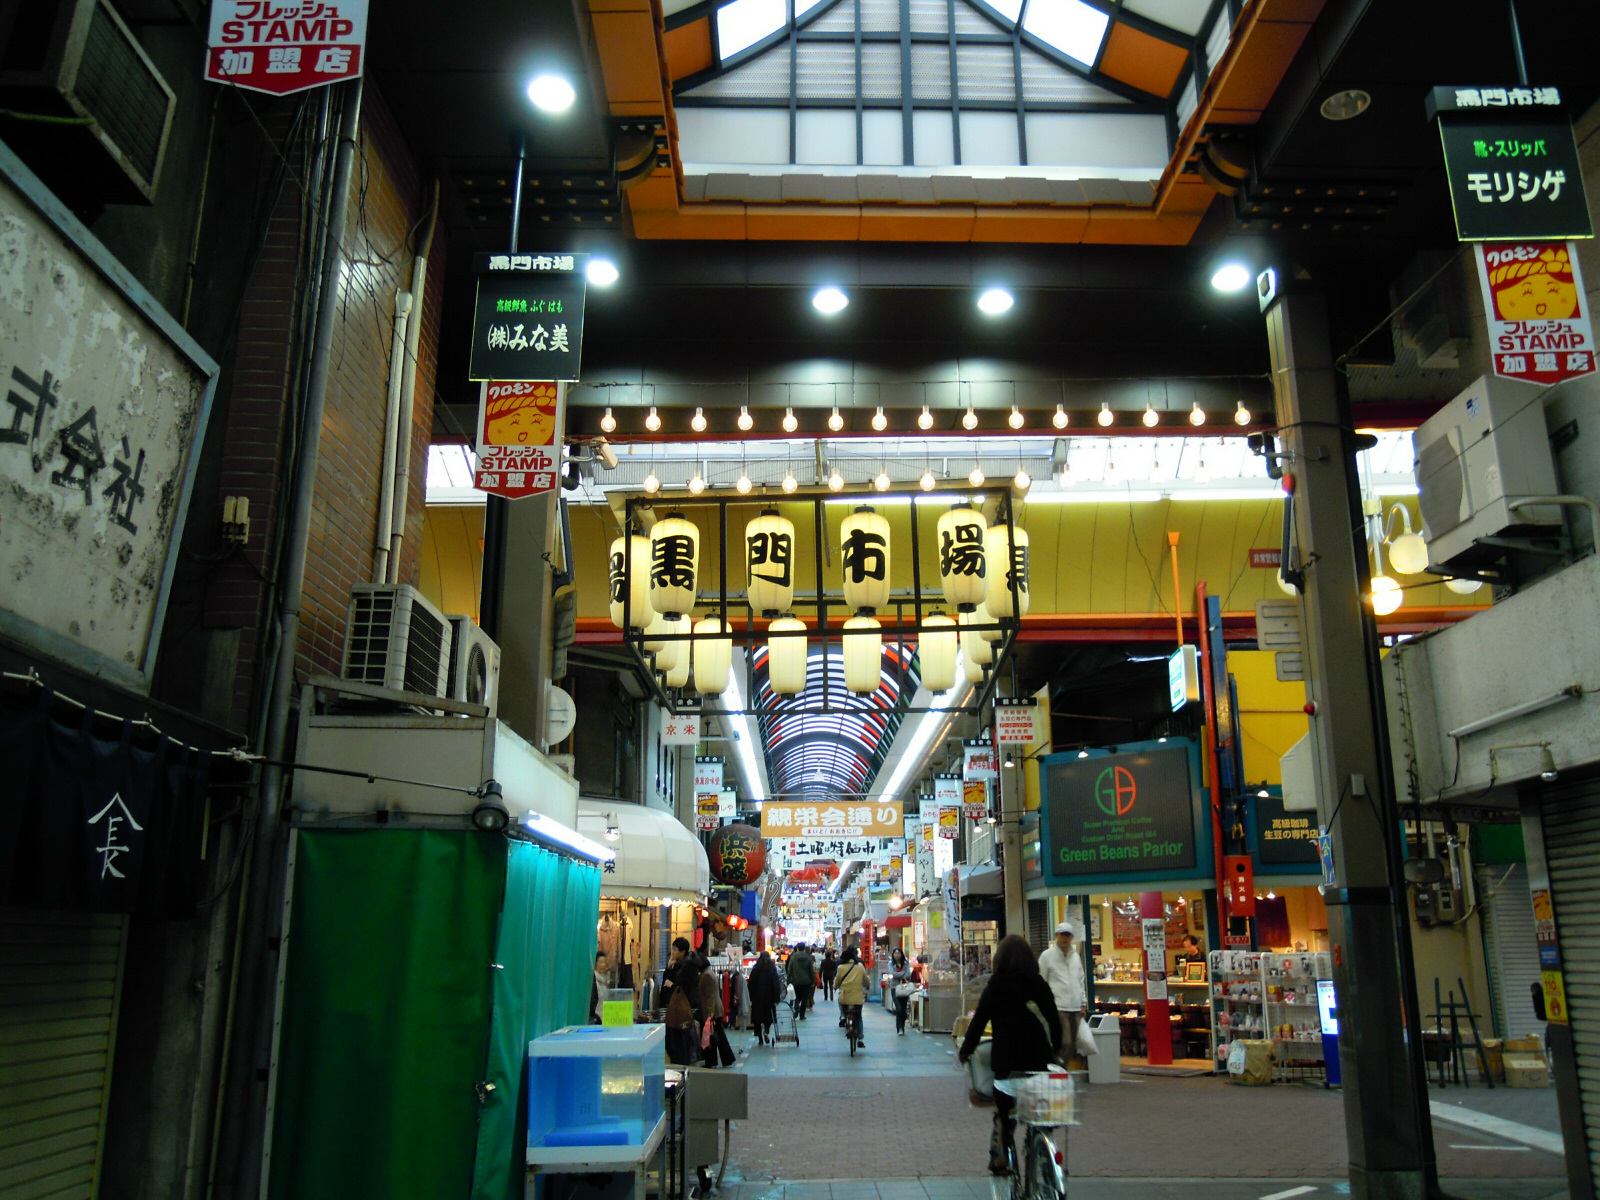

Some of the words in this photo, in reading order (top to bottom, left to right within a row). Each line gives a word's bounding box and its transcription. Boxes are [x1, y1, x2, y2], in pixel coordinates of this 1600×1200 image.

[235, 0, 339, 20] フレッシュ
[221, 19, 353, 43] STAMP
[218, 47, 352, 75] 加盟店
[1455, 87, 1560, 107] 黒門市場
[1467, 170, 1566, 203] モリシゲ
[489, 255, 575, 270] 黒門市場
[1487, 246, 1539, 267] クロモン
[1503, 320, 1573, 335] フレッシュ
[1498, 334, 1585, 351] STAMP
[1501, 352, 1589, 373] 加盟店
[488, 383, 535, 400] クロモン
[487, 446, 545, 457] フレッシュ
[481, 457, 553, 470] STAMP
[480, 472, 552, 488] 加盟店
[1059, 846, 1097, 863] Green
[1099, 844, 1140, 861] Beans
[1142, 840, 1185, 856] Parlor
